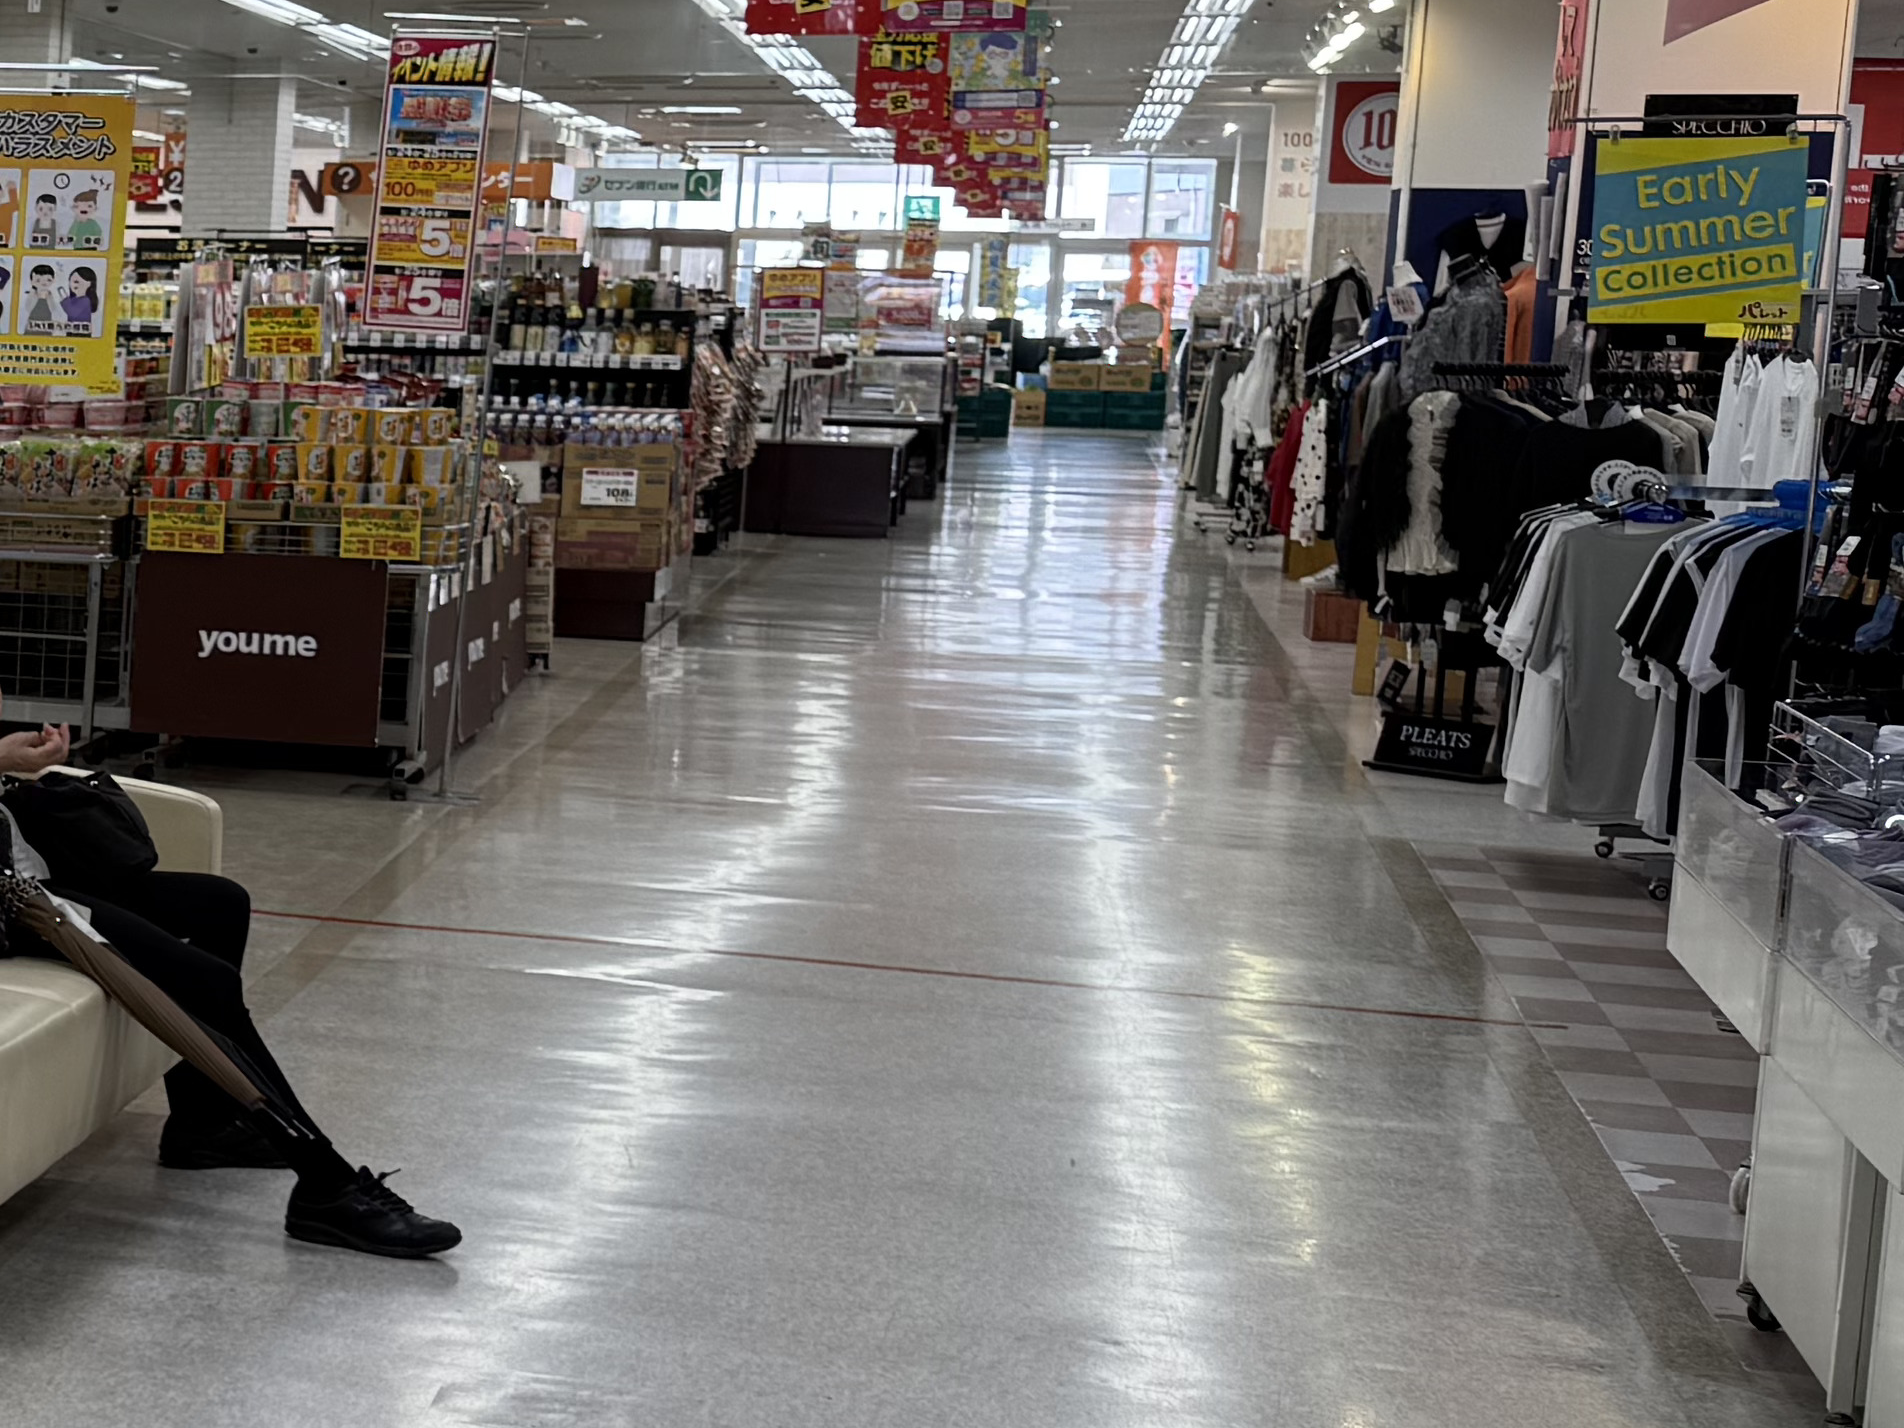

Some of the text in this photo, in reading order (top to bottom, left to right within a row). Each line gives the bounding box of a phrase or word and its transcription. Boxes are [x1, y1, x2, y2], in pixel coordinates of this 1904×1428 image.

[870, 42, 939, 69] 値下げ
[406, 160, 476, 174] ゆめアプリ
[1635, 164, 1761, 210] Early
[1599, 206, 1797, 259] Summer
[1601, 252, 1788, 293] Collection
[1737, 301, 1789, 320] パレット
[197, 629, 319, 659] youme
[1399, 724, 1472, 749] PLEATS
